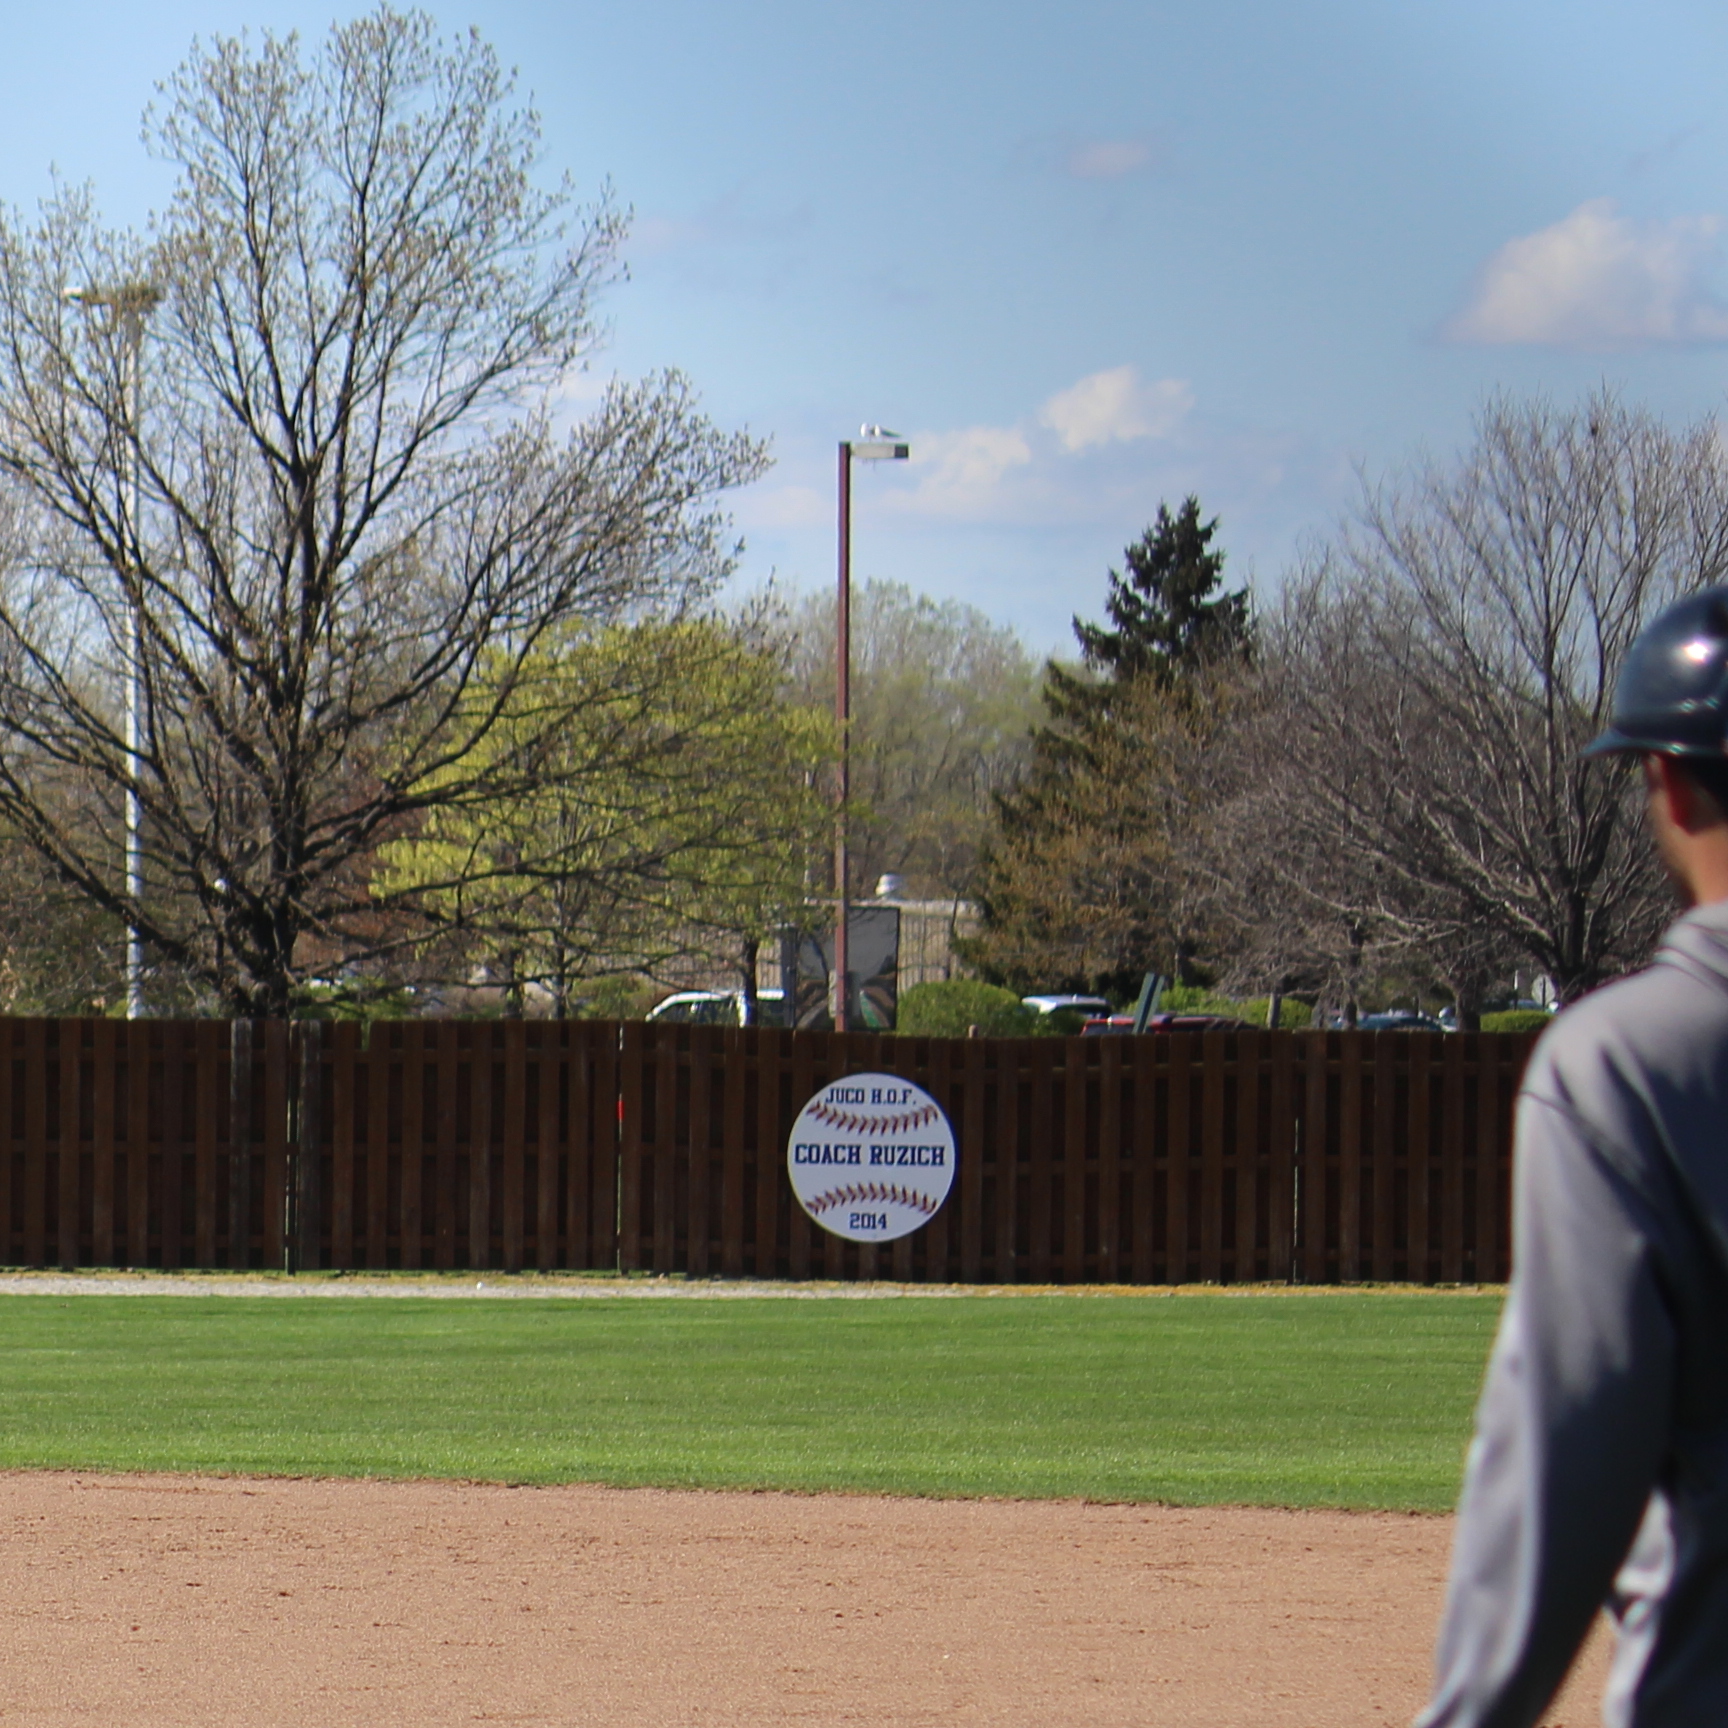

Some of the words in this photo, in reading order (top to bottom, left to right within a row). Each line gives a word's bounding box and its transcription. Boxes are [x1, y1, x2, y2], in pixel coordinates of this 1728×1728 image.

[825, 1087, 865, 1104] JUCO
[871, 1088, 917, 1105] H.O.F.
[794, 1143, 861, 1165] COACH
[869, 1145, 945, 1166] RUZICH
[849, 1213, 887, 1229] 2014
